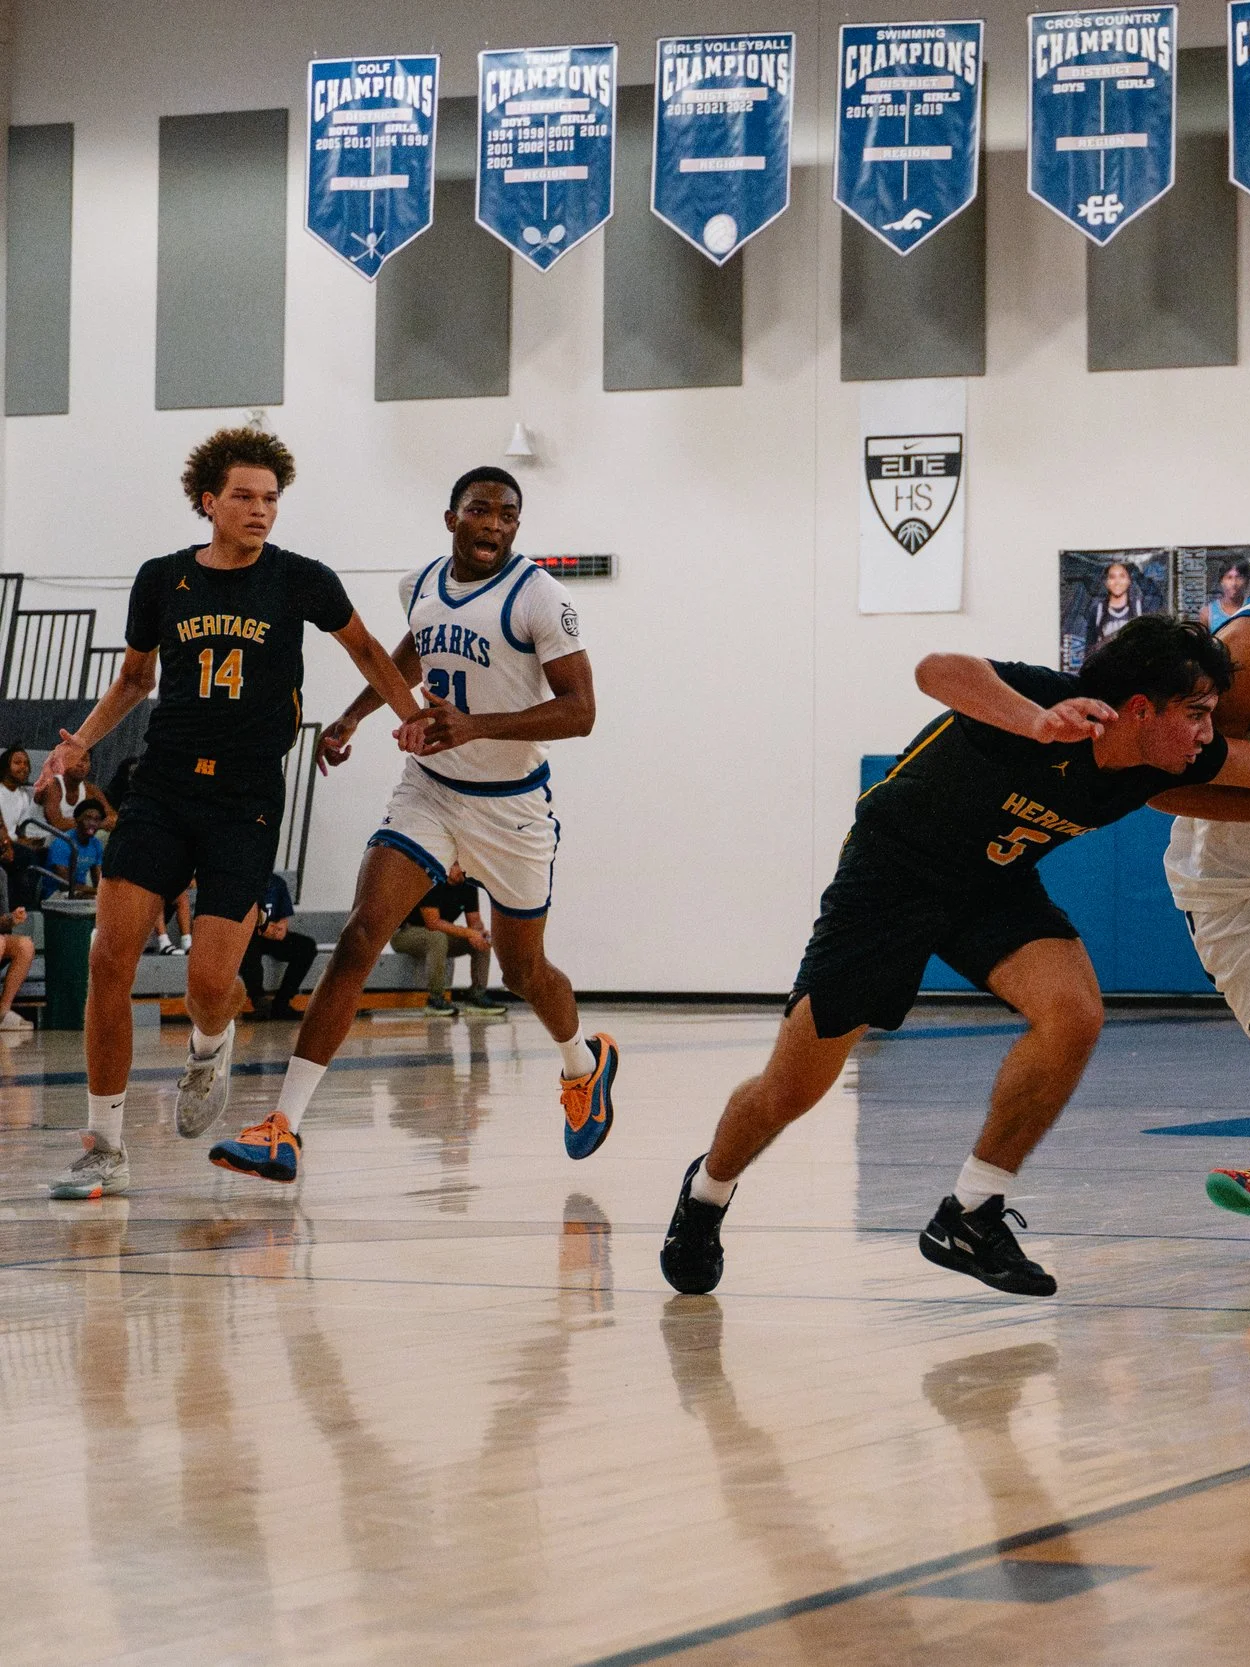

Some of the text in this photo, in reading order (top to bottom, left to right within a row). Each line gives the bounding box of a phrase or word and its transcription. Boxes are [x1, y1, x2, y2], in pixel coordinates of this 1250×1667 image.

[1045, 12, 1160, 30] CROSS COUNTRY
[876, 28, 946, 40] SWIMMING
[664, 39, 788, 55] GIRLS VOLLEYBALL
[1036, 26, 1170, 79] CHAMPIONS
[358, 63, 392, 74] GOLF
[845, 42, 976, 88] CHAMPIONS
[1072, 65, 1131, 77] DISTRICT
[662, 53, 788, 102] CHAMPIONS
[1116, 78, 1155, 90] GIRLS
[486, 64, 610, 113] CHAMPIONS
[1052, 82, 1086, 94] BOYS
[314, 75, 432, 122] CHAMPIONS
[696, 102, 724, 115] 2021
[846, 106, 874, 118] 2014
[580, 124, 608, 137] 2010
[1078, 136, 1124, 148] REGION
[883, 148, 930, 158] REGION
[881, 455, 946, 476] ELITE
[895, 483, 932, 512] HS
[176, 614, 270, 644] HERITAGE
[415, 624, 490, 668] SHARKS
[198, 648, 243, 700] 14
[428, 668, 470, 714] 21
[986, 826, 1051, 866] 5
